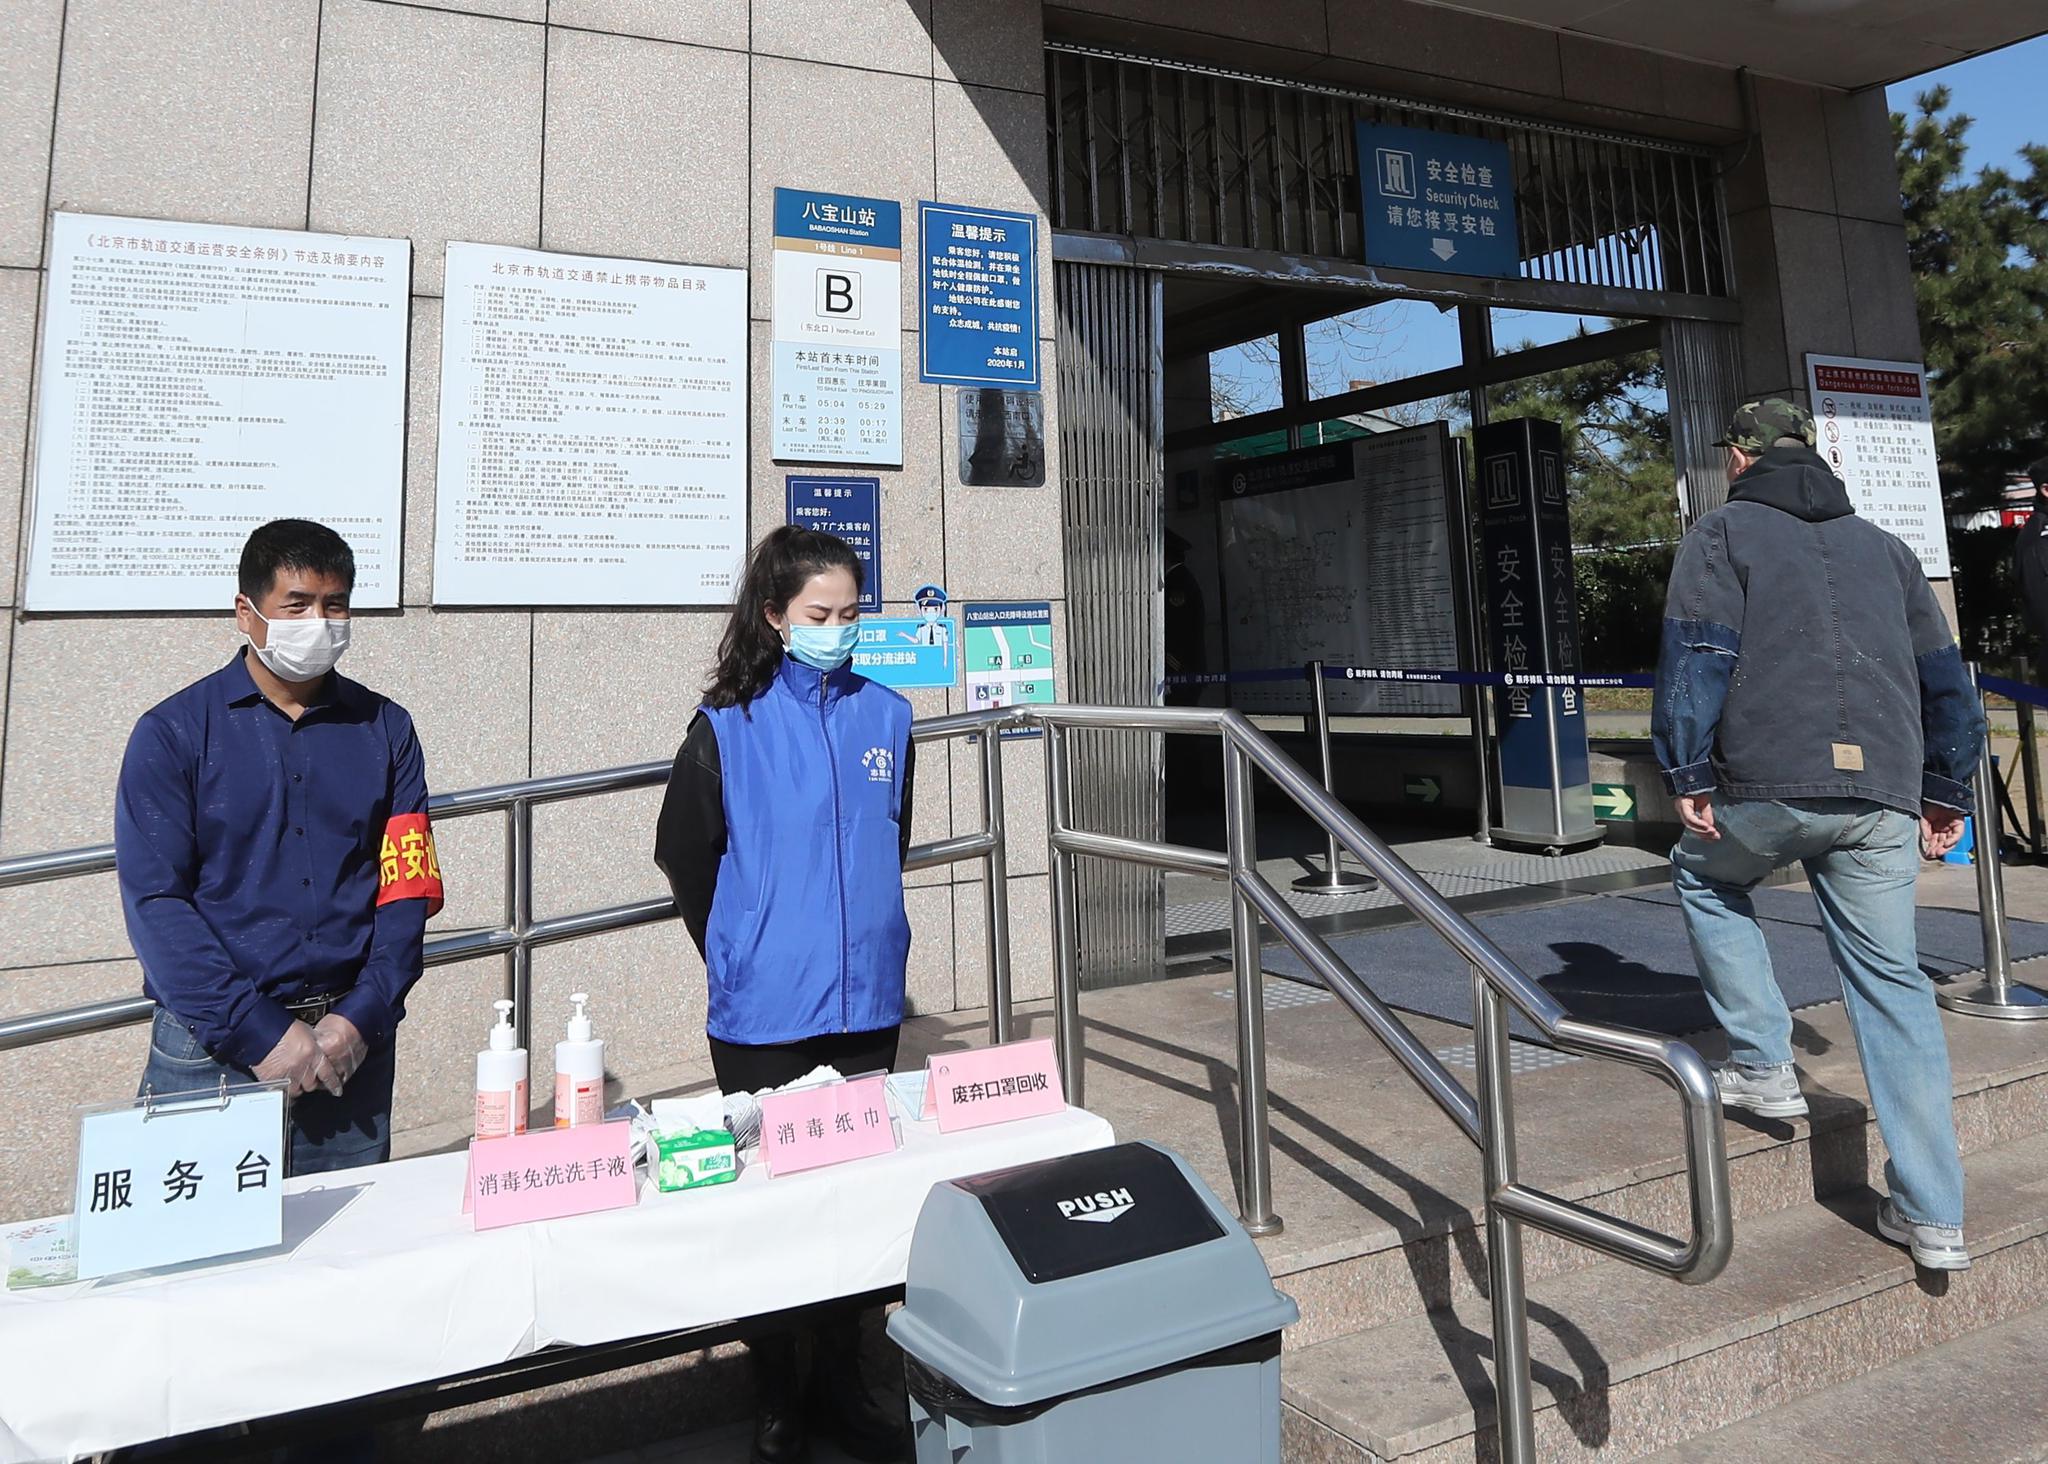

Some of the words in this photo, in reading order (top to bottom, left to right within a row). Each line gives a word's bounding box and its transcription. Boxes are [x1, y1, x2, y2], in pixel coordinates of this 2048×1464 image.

[1426, 159, 1493, 188] 安全检查
[1426, 188, 1468, 210] Security
[1469, 193, 1500, 211] Check
[802, 201, 877, 228] 八宝山站
[1387, 205, 1496, 237] 请您接受安检
[809, 224, 848, 234] BABAOSHAN
[849, 229, 869, 237] Station
[952, 223, 1006, 243] 温馨提示
[815, 243, 836, 253] 1号线
[840, 246, 857, 255] Line
[492, 262, 707, 292] 北京市轨道交通禁止携带物品目录
[826, 274, 853, 313] B
[795, 350, 879, 367] 本站首末车时间
[993, 346, 1018, 357] 本站启
[987, 357, 1026, 370] 2020年1月
[817, 399, 845, 408] 05:04
[858, 401, 885, 410] 05:29
[818, 416, 845, 425] 23:39
[859, 418, 887, 427] 00:17
[818, 427, 846, 436] 00:40
[860, 429, 887, 438] 01:20
[813, 488, 852, 498] 温馨提示
[812, 522, 870, 532] 为了广大乘客的
[1497, 544, 1532, 718] 安全检查
[1551, 542, 1578, 716] 安全检查
[995, 657, 1002, 665] A
[1025, 655, 1031, 663] B
[952, 1072, 1049, 1105] 废弃口罩回收
[776, 1107, 881, 1145] 消毒纸巾
[90, 1149, 272, 1213] 服务台
[478, 1154, 628, 1197] 消毒免洗洗手液
[1056, 1186, 1134, 1219] PUSH
